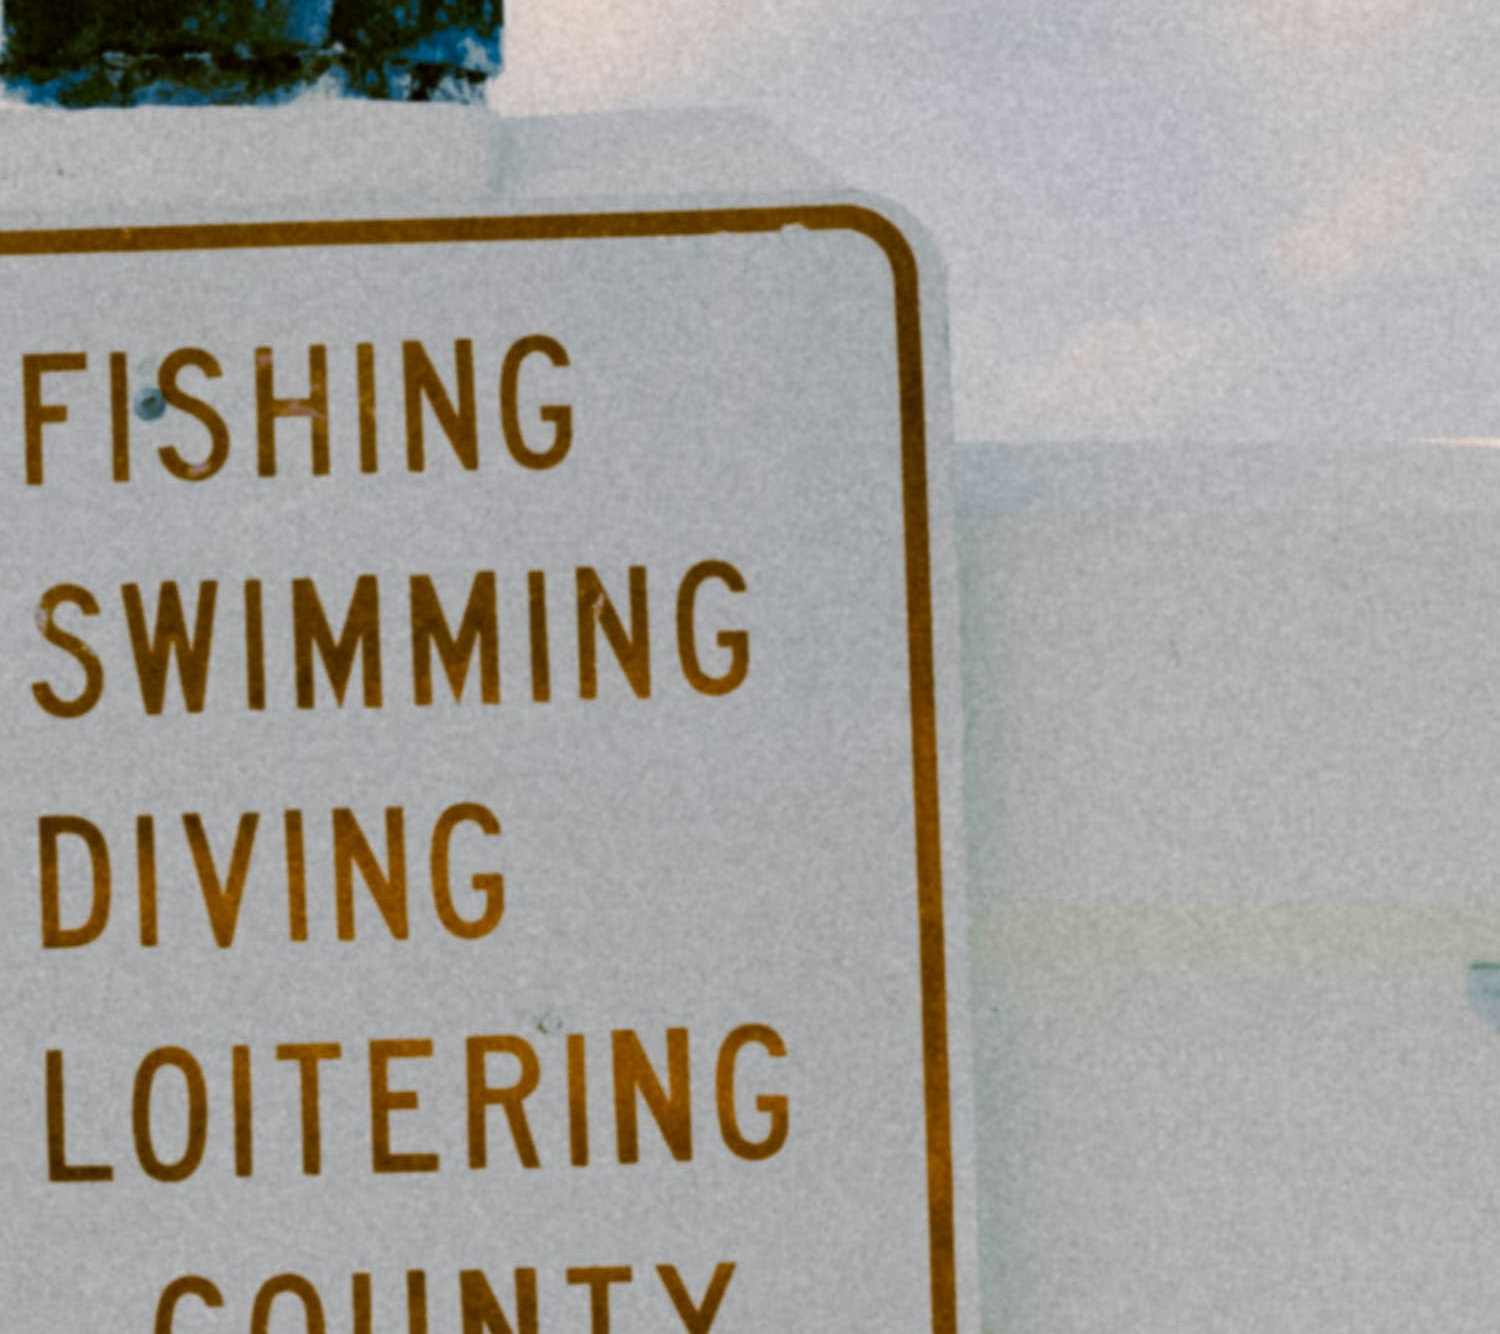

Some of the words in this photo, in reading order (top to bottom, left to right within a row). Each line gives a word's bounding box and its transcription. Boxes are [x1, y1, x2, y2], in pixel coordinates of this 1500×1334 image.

[22, 334, 573, 486] FISHING
[31, 559, 751, 720] SWIMMING
[37, 802, 506, 950] DIVING
[44, 1023, 790, 1184] LOITERING
